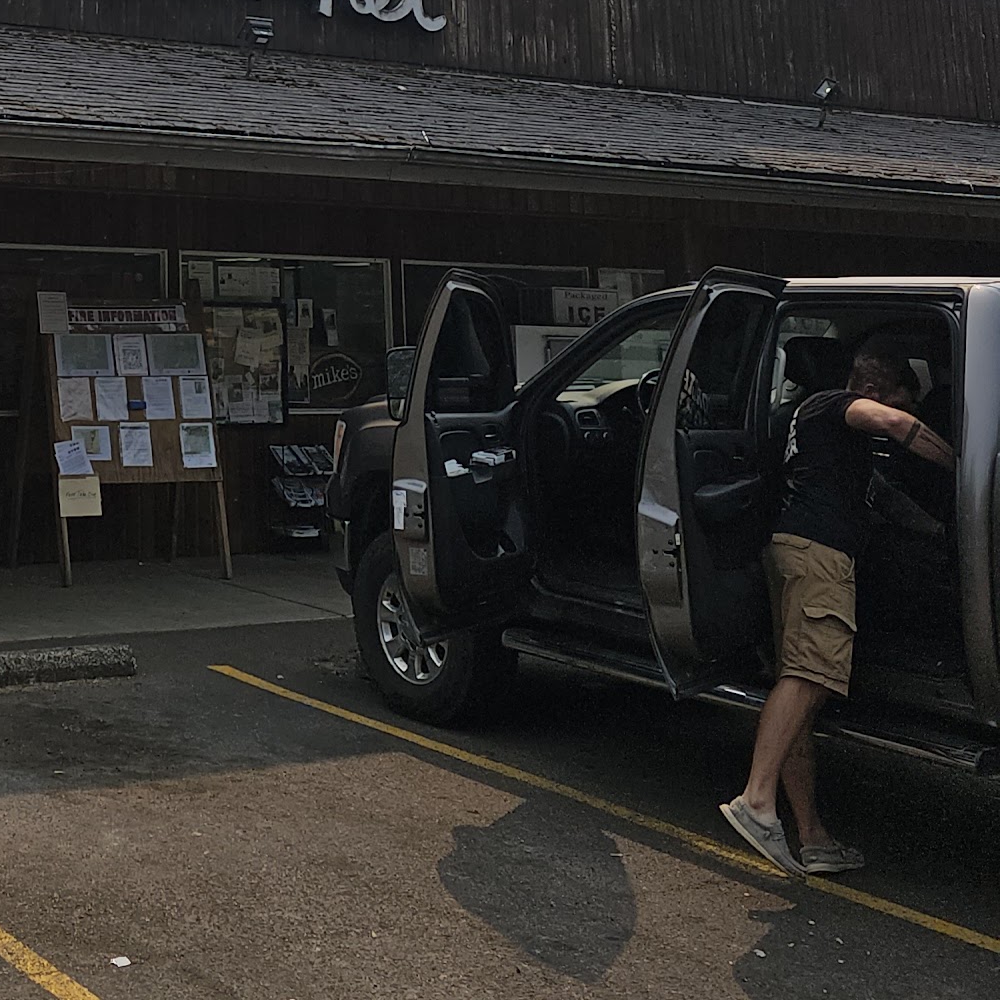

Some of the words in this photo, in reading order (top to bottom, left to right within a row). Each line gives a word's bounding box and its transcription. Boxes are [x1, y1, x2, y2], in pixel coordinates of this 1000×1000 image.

[564, 291, 608, 301] Packaged
[67, 310, 96, 322] FIRE
[97, 309, 177, 322] INFORMATION
[568, 306, 605, 323] ICE
[311, 364, 359, 390] mike's
